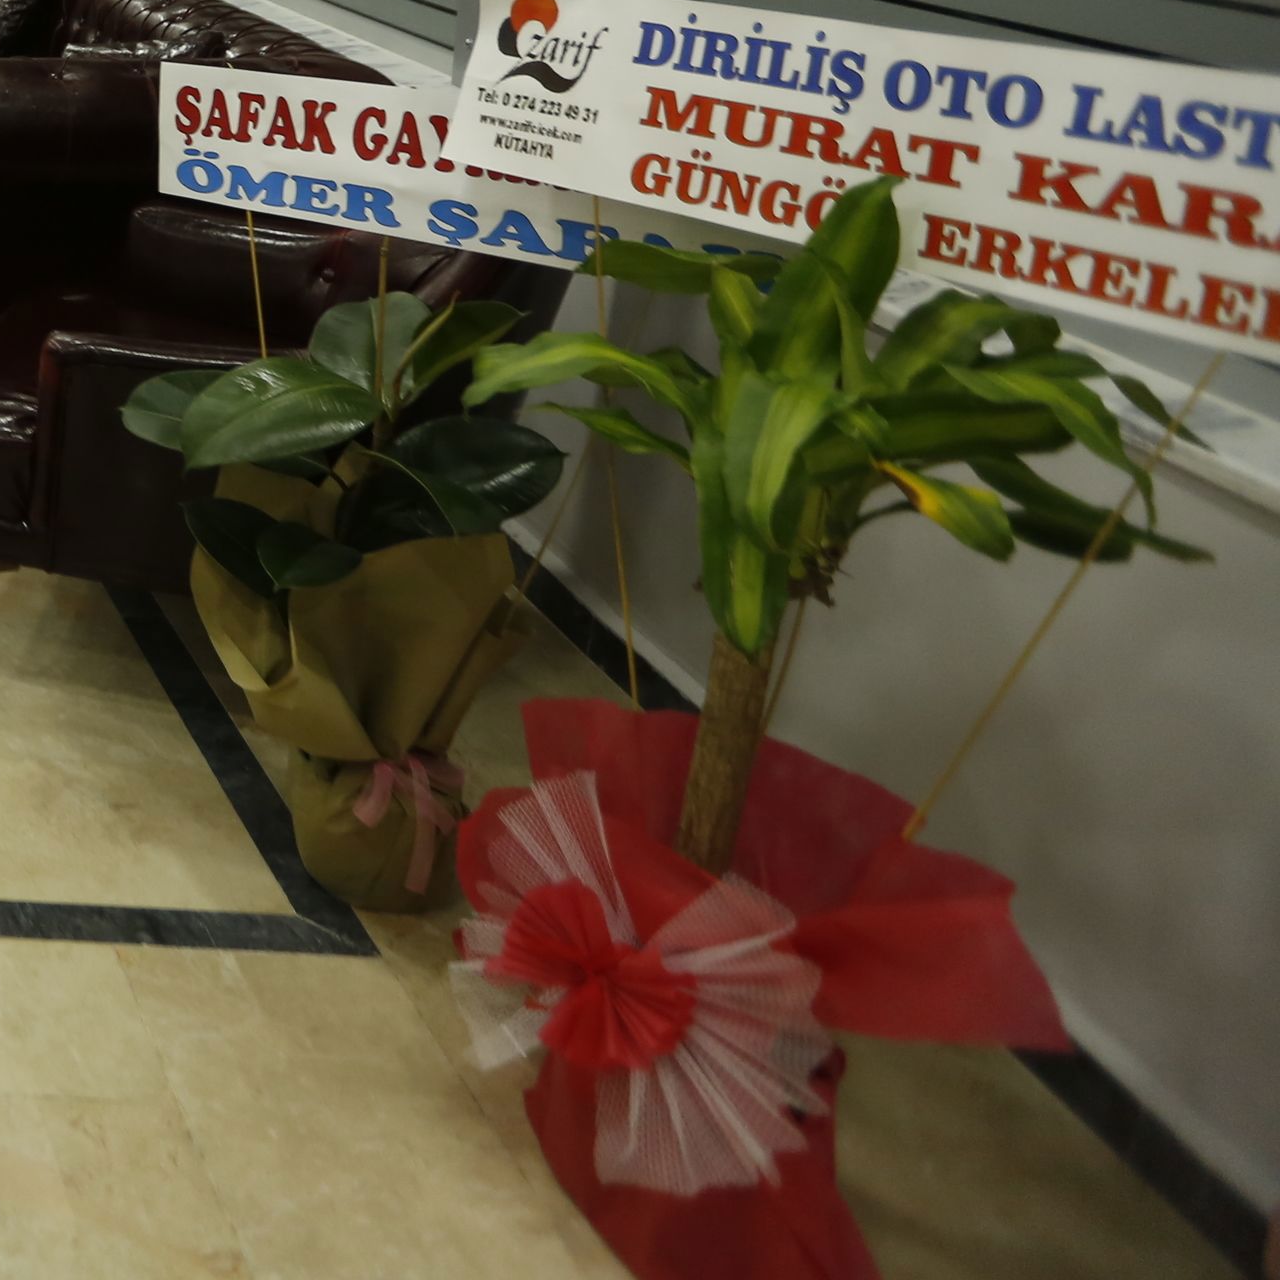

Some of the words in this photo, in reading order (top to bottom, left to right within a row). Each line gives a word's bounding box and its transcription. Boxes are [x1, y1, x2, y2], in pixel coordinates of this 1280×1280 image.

[502, 92, 511, 107] 0
[512, 94, 537, 112] 274
[538, 98, 563, 117] 223
[582, 107, 599, 125] 31
[632, 12, 866, 115] DİRİLİŞ
[883, 59, 1043, 129] OTO
[175, 84, 337, 156] ŞAFAK
[493, 131, 554, 159] KÜTAHYA
[176, 148, 401, 227] ÖMER
[631, 148, 847, 234] GÜNGÖ
[639, 85, 980, 188] MURAT
[1007, 151, 1280, 253] KAR
